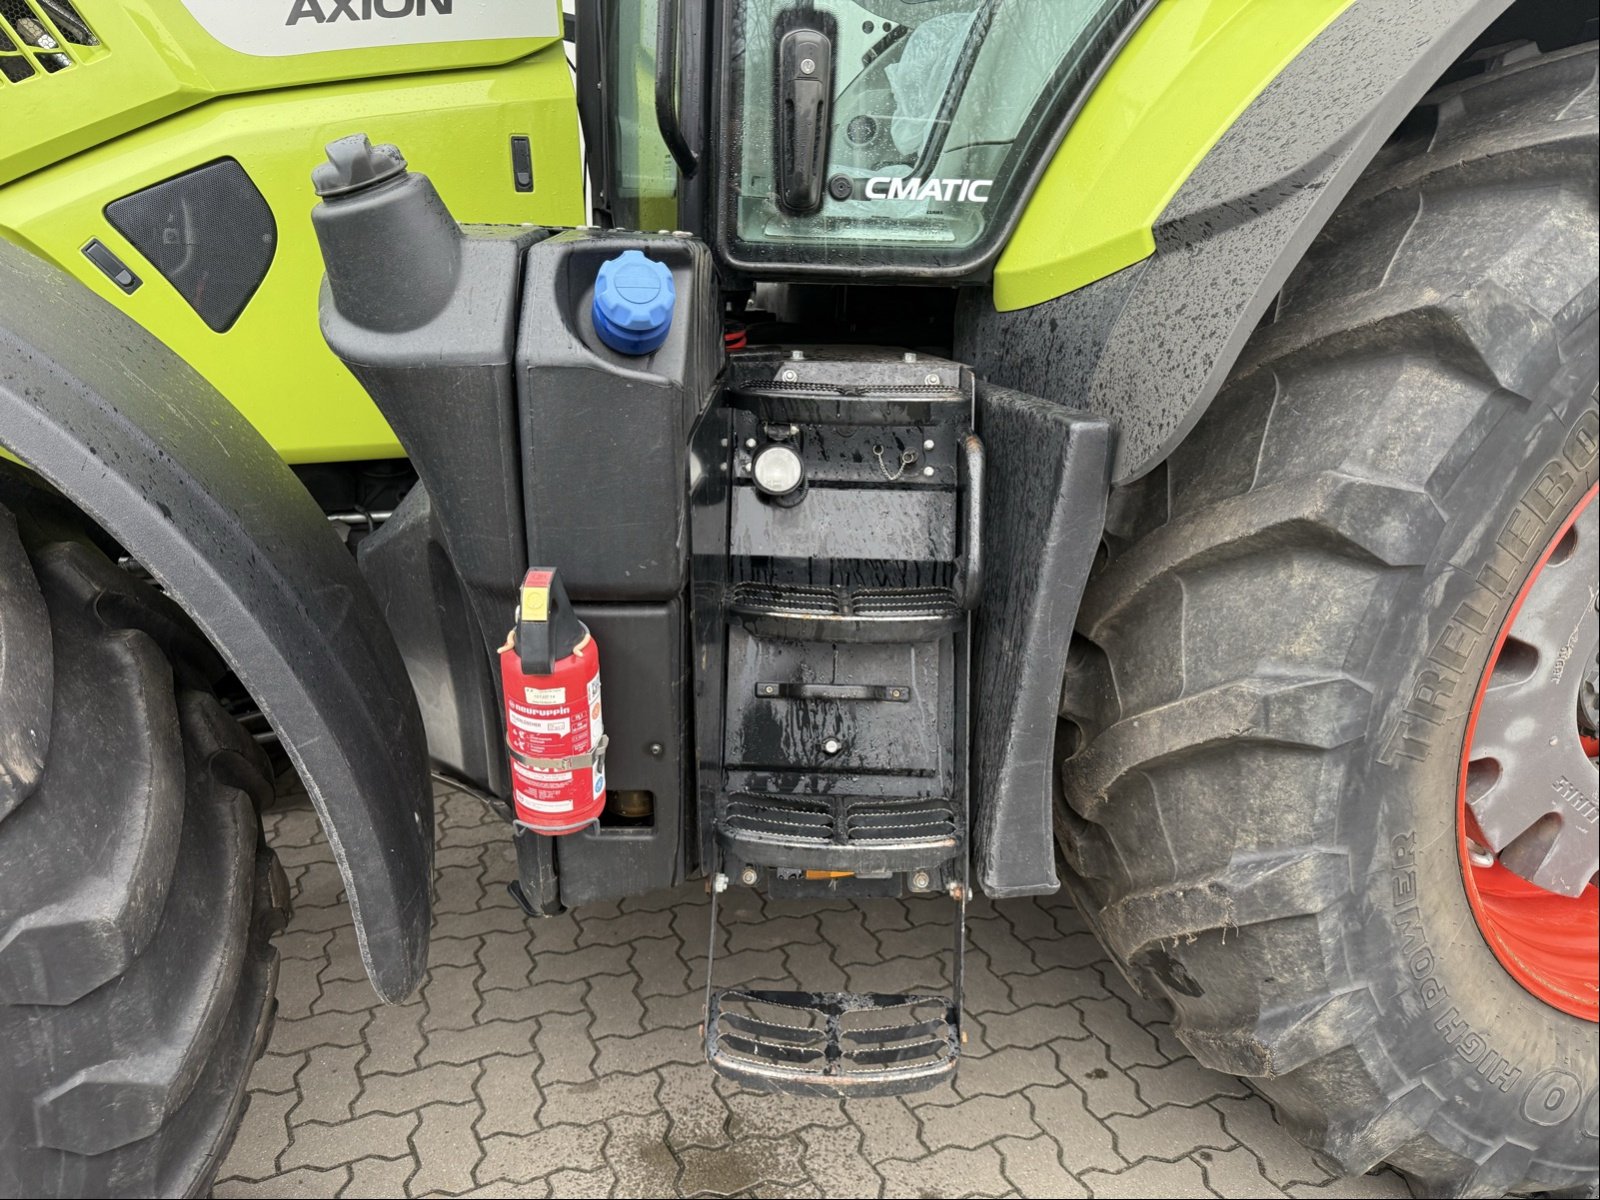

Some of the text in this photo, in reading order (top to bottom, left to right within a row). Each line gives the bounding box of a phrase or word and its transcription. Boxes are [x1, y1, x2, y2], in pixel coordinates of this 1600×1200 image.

[865, 177, 993, 202] CMATIC
[1375, 382, 1599, 765] TRELLEBO
[515, 703, 570, 717] neuruppin
[1390, 829, 1450, 1010] POWER
[1434, 1006, 1522, 1093] HIGH
